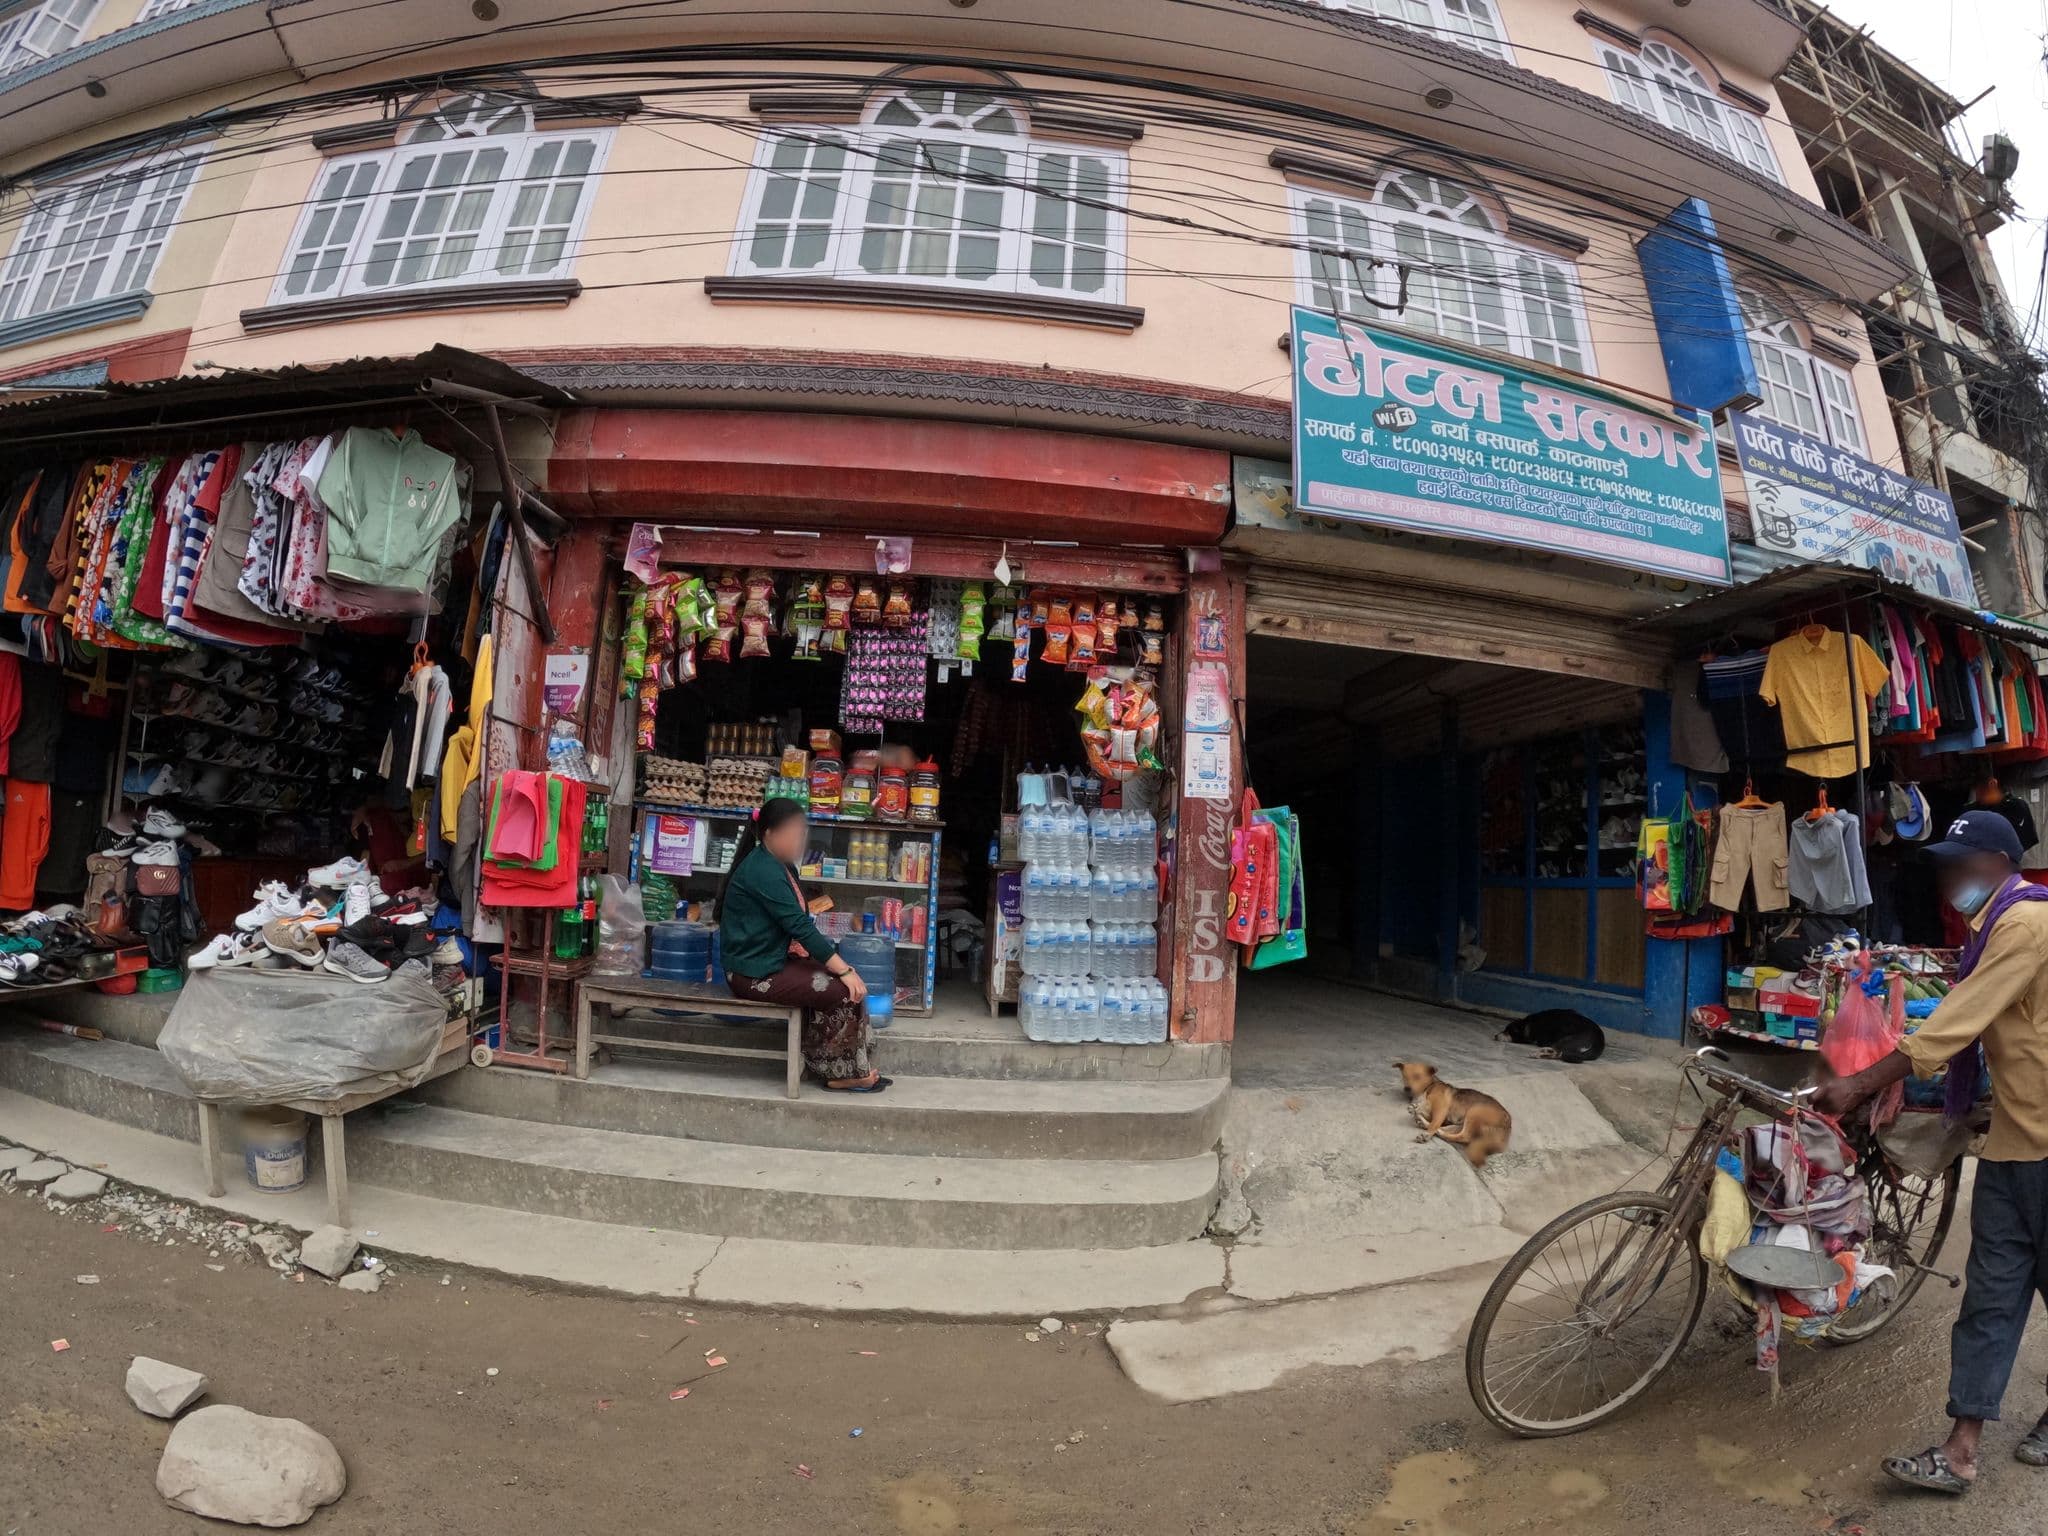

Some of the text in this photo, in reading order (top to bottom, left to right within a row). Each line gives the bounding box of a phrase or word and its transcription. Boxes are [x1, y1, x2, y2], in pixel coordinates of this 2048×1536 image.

[1302, 324, 1713, 478] होटल सत्कार
[1304, 418, 1355, 442] सम्पर्क
[1430, 420, 1469, 442] नयाँ
[1549, 446, 1629, 478] काठमाण्डौ
[1370, 453, 1399, 471] खान
[1401, 459, 1426, 475] तथा
[1470, 472, 1499, 490] लागि
[1500, 477, 1529, 496] उचित
[1740, 423, 1785, 461] पर्वत
[1913, 490, 1950, 522] हाउस
[1449, 483, 1482, 502] टिकट
[1514, 495, 1558, 518] टिकटको
[1559, 506, 1579, 522] सेवा
[551, 671, 571, 679] Ncell
